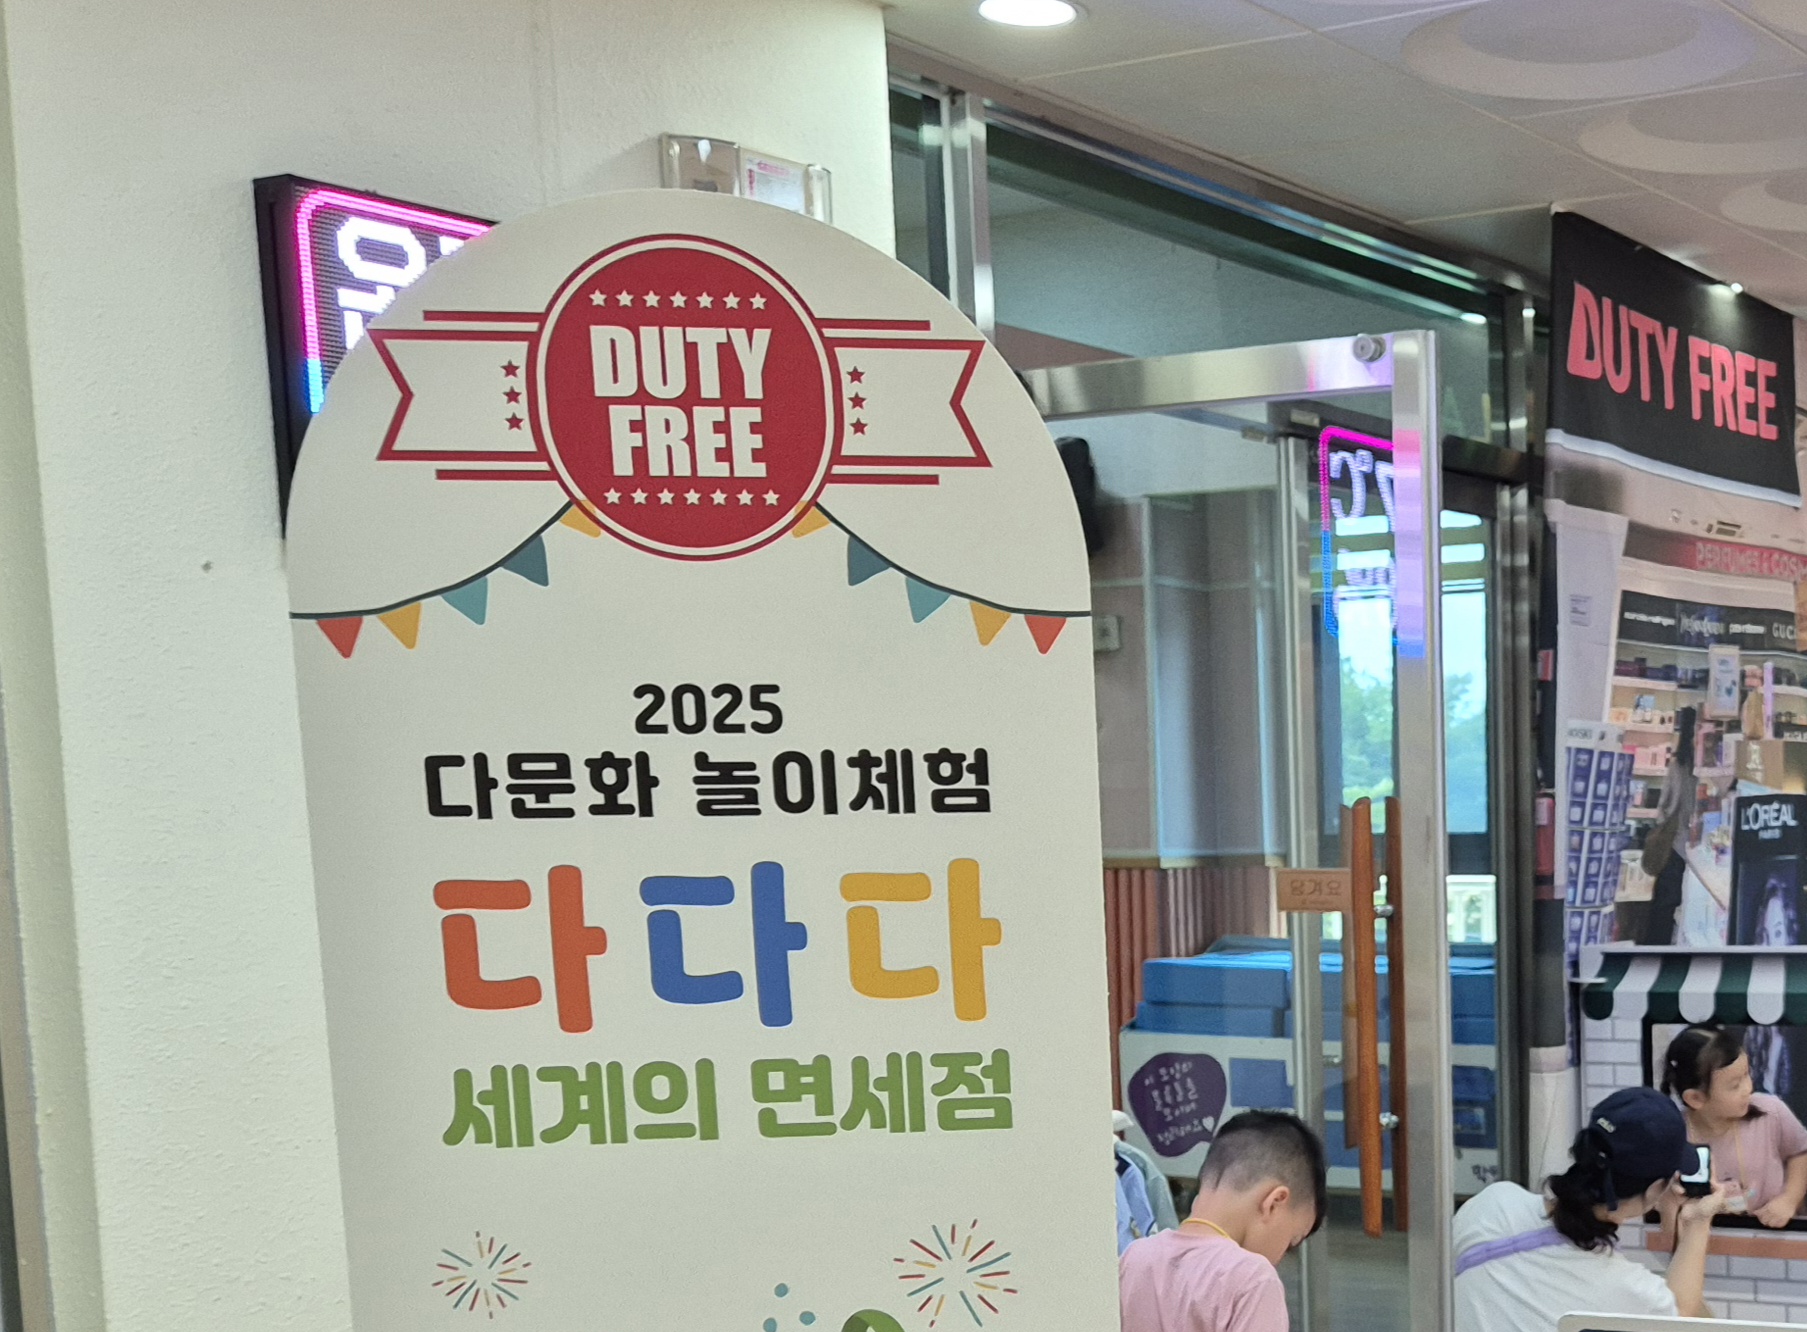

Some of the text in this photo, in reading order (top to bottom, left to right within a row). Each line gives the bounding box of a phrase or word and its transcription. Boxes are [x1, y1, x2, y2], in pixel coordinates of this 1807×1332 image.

[589, 325, 772, 401] DUTY
[1566, 281, 1779, 441] DUTY FREE
[608, 406, 767, 479] FREE
[634, 684, 784, 735] 2025
[424, 747, 992, 820] 다문화 놀이체험
[433, 857, 1002, 1034] 다다다
[442, 1048, 1013, 1148] 세계의 면세점
